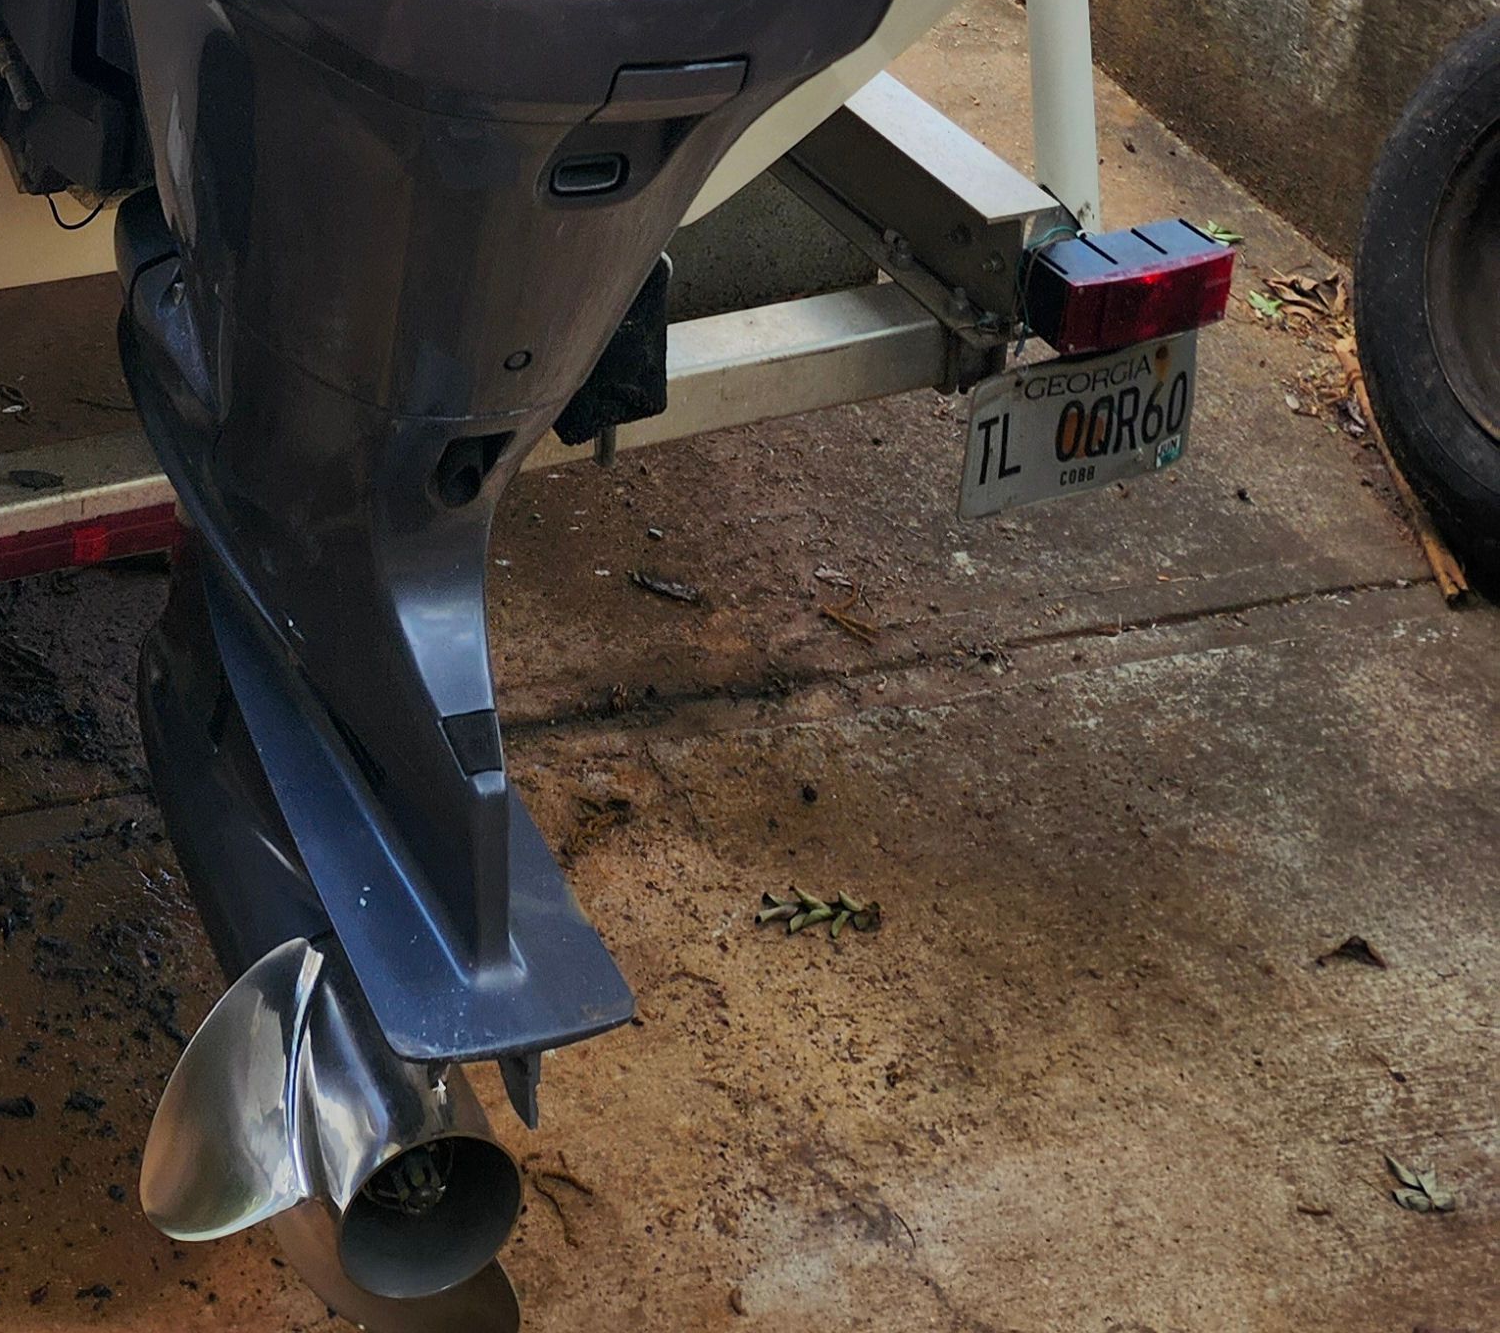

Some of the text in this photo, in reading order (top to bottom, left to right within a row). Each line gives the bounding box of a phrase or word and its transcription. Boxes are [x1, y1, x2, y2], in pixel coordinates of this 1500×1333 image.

[1023, 355, 1152, 401] GEORGIA
[977, 412, 1021, 486] TL
[1059, 466, 1096, 486] COBB
